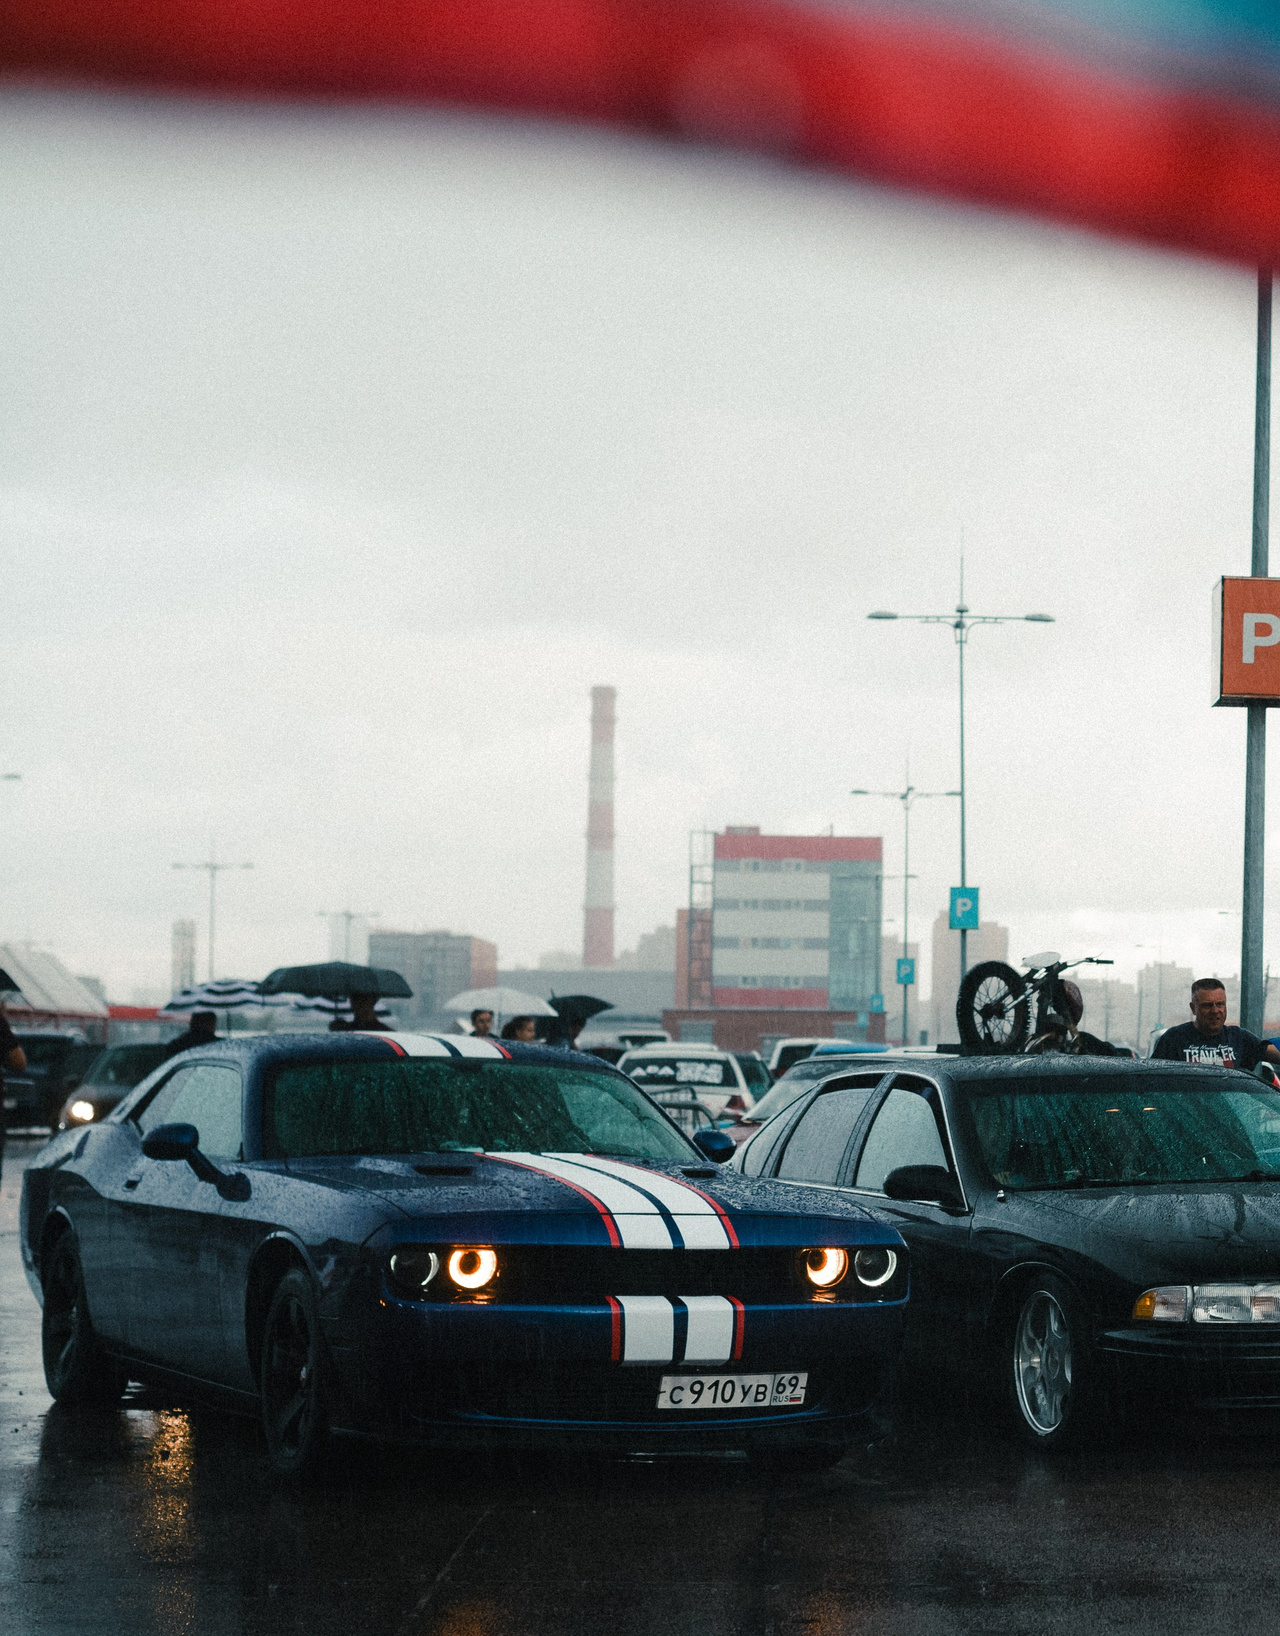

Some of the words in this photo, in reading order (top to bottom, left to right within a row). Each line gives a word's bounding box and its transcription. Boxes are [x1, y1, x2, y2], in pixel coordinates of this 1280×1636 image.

[956, 898, 972, 918] P
[900, 964, 911, 978] P
[669, 1379, 768, 1404] С910УВ
[775, 1375, 800, 1395] 69
[772, 1395, 789, 1403] RUS
